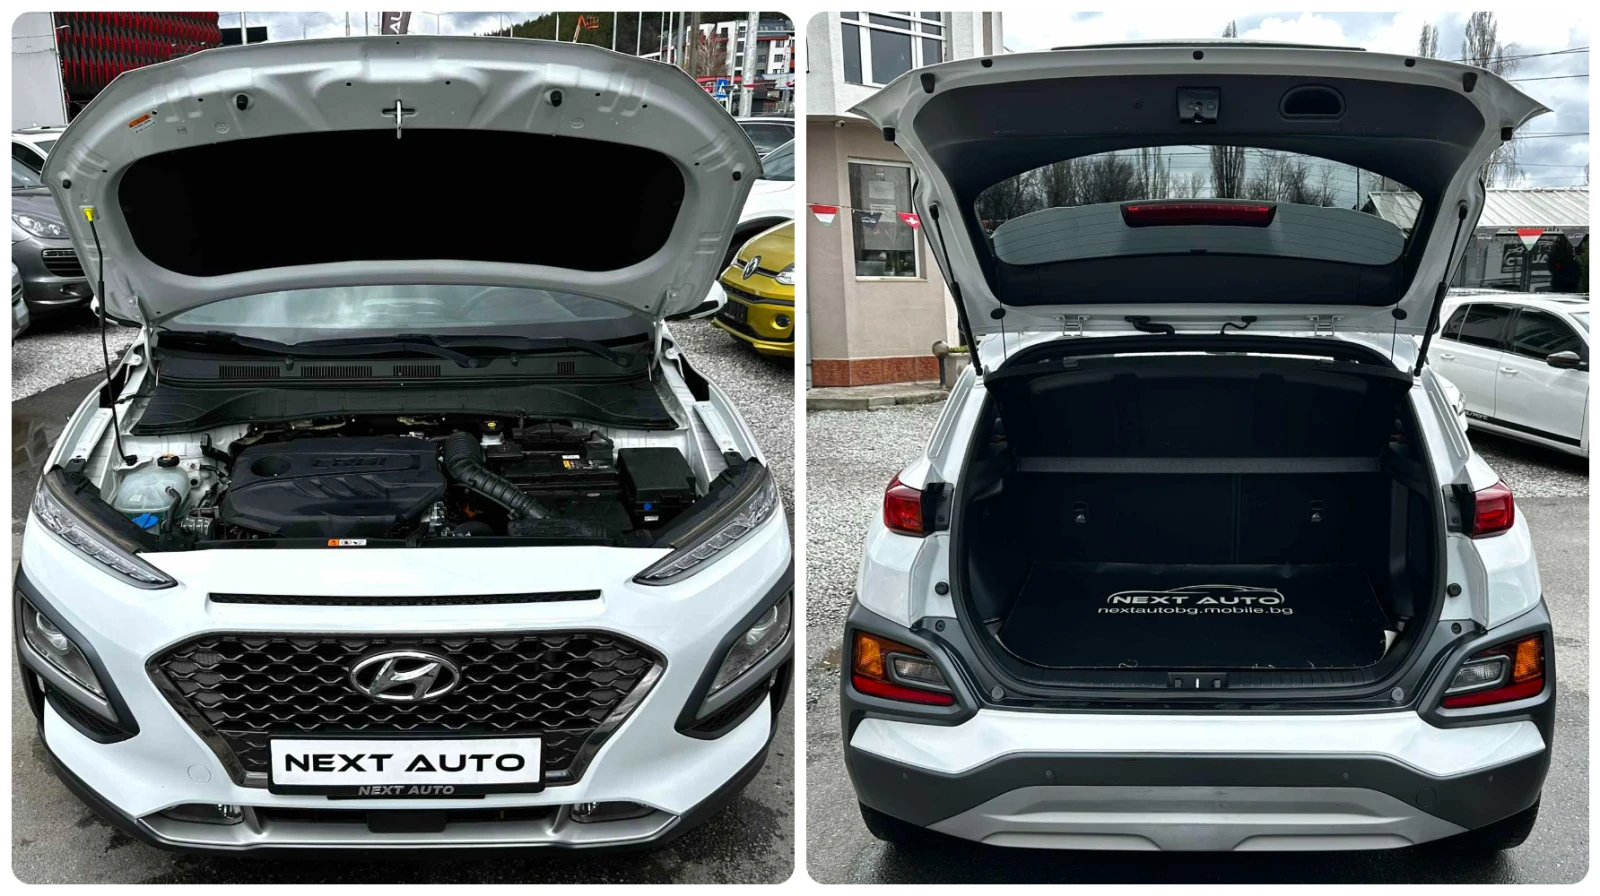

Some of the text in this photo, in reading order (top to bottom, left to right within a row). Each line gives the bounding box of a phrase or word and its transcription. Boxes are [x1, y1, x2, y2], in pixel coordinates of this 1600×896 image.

[1112, 596, 1281, 605] NEXT AUTO
[1097, 606, 1294, 615] nextautobg.mobile.bg
[285, 753, 525, 772] NEXT AUTO
[358, 785, 455, 796] NEXT AUTO
